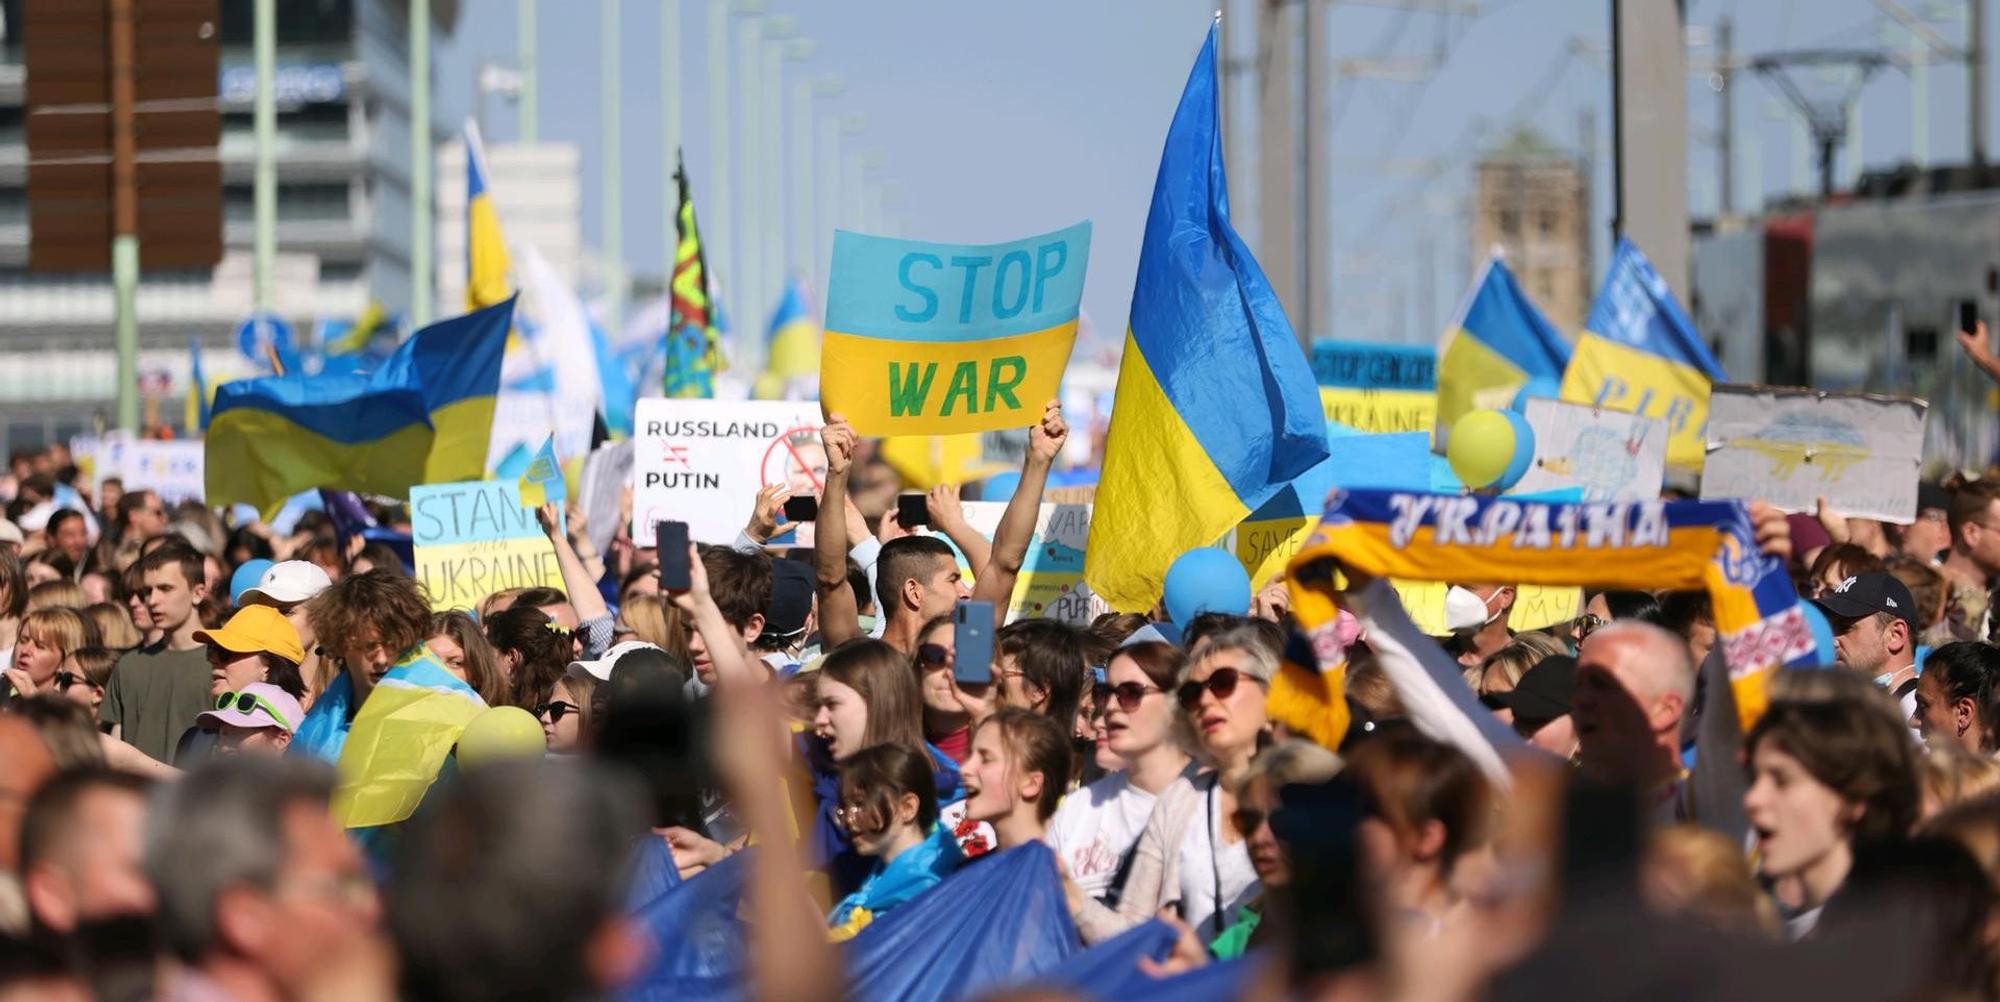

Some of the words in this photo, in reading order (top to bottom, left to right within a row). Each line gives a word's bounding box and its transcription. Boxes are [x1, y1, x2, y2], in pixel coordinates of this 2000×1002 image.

[894, 240, 1067, 323] STOP
[888, 355, 1027, 417] WAR
[647, 421, 778, 438] RUSSLAND
[646, 472, 720, 489] PUTIN
[417, 487, 542, 541] STAN
[1246, 527, 1299, 564] SAVE
[423, 551, 558, 604] UKRAINE
